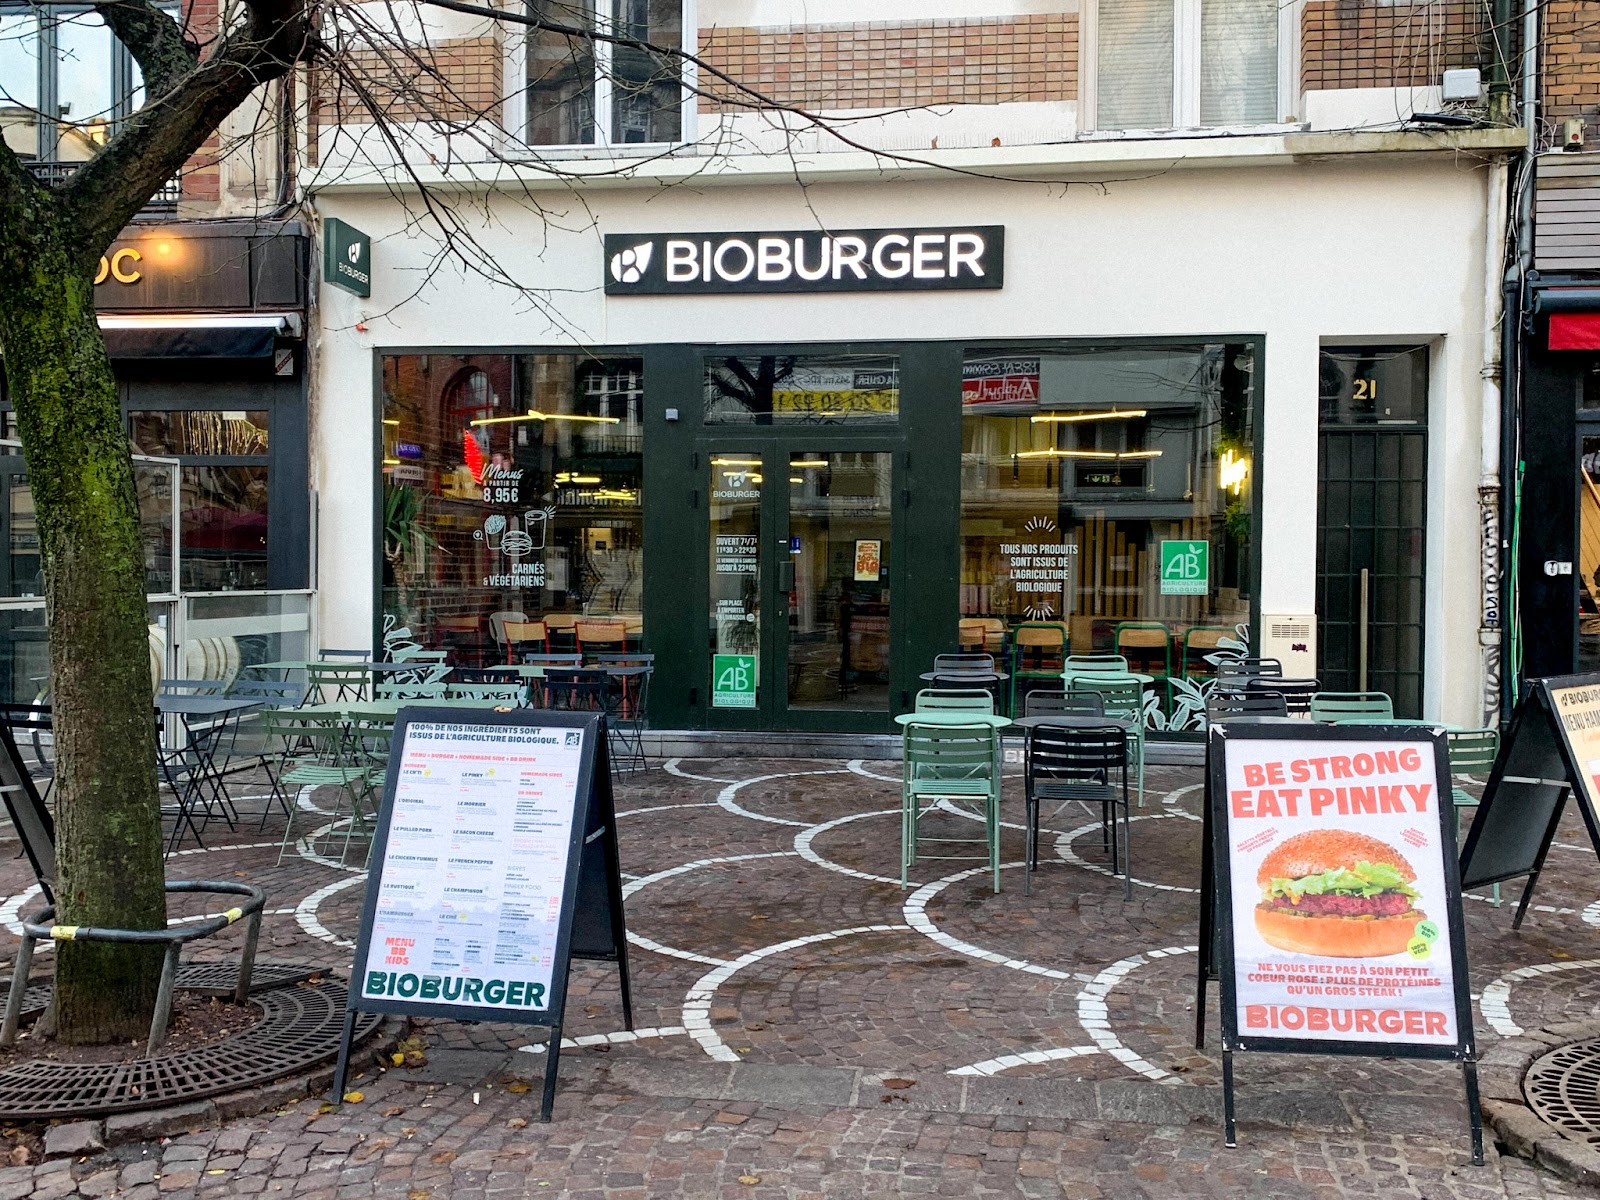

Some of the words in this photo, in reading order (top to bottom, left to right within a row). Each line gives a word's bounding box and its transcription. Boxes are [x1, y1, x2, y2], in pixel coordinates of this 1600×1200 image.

[667, 234, 985, 282] BIOBURGER
[339, 262, 368, 284] BIOBURGER
[1352, 379, 1376, 399] 21
[480, 463, 523, 480] Menus
[483, 488, 518, 504] 8,95€
[1000, 545, 1020, 554] TOUS
[1022, 545, 1037, 554] NOS
[1039, 544, 1078, 554] PRODUITS
[512, 562, 544, 574] CARNÉS
[1010, 557, 1031, 567] SONT
[1033, 557, 1056, 567] ISSUS
[1058, 557, 1068, 567] DE
[1165, 554, 1200, 578] AB
[489, 574, 544, 586] VÉGÉTARIENS
[1010, 570, 1068, 580] L'AGRICULTURE
[1016, 582, 1062, 592] BIOLOGIQUE
[717, 667, 748, 690] AB
[464, 724, 518, 734] INGRÉDIENTS
[446, 734, 506, 742] L'AGRICULTURE
[508, 736, 559, 744] BIOLOGIQUE.
[1243, 762, 1286, 787] BE
[1290, 748, 1421, 783] STRONG
[1231, 789, 1302, 818] EAT
[1309, 784, 1432, 816] PINKY
[385, 937, 416, 947] MENU
[391, 947, 406, 955] BB
[385, 956, 409, 965] KIDS
[1258, 963, 1273, 971] NE
[1275, 964, 1306, 973] VOUS
[1308, 965, 1332, 974] FIEZ
[1335, 966, 1357, 975] PAS
[1360, 964, 1368, 975] À
[1369, 966, 1393, 976] SON
[1395, 967, 1429, 977] PETIT
[1248, 973, 1285, 983] COEUR
[1288, 975, 1318, 984] ROSE
[1326, 976, 1356, 985] PLUS
[1359, 977, 1374, 986] DE
[1376, 976, 1440, 987] PROTÉINES
[366, 971, 546, 1007] BIOBURGER
[1287, 985, 1322, 995] QU'UN
[1325, 986, 1357, 996] GROS
[1359, 987, 1396, 996] STEAK
[1246, 1005, 1449, 1036] BIOBURGER
